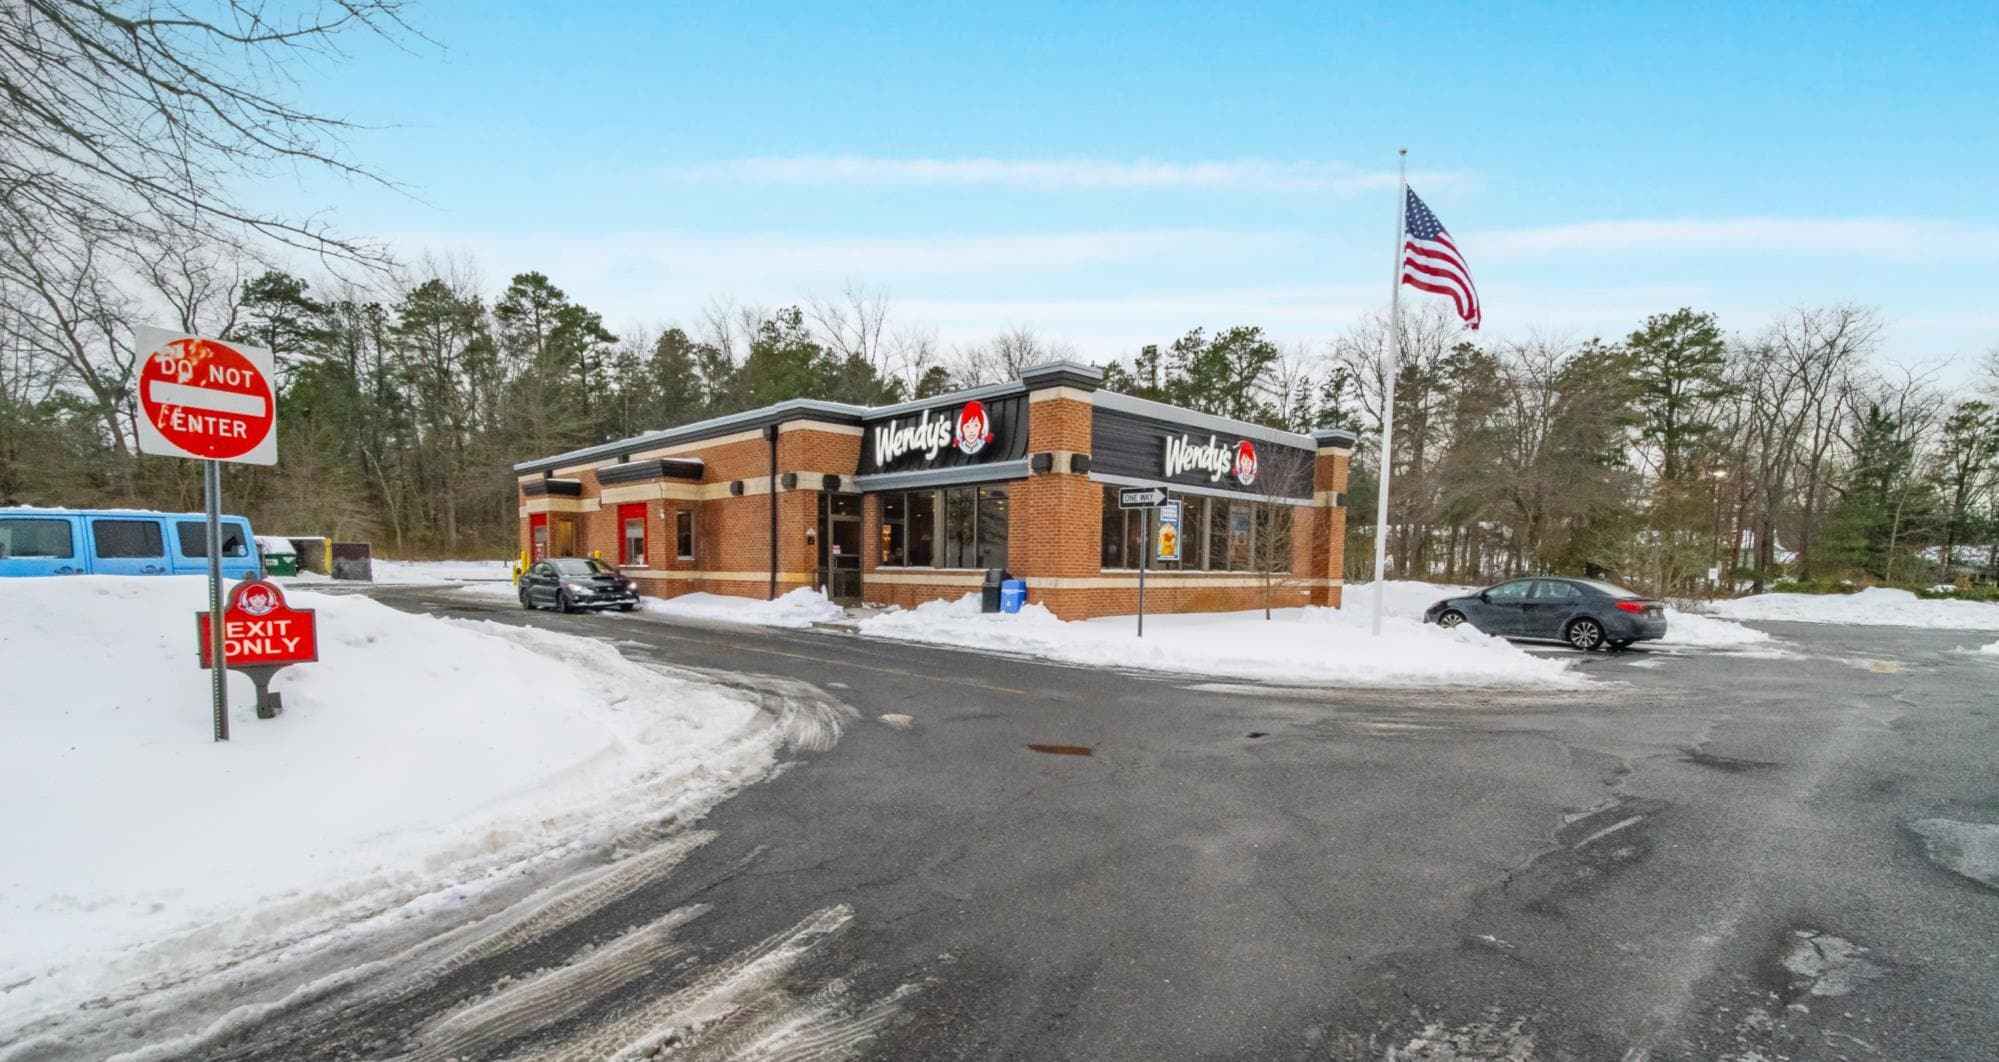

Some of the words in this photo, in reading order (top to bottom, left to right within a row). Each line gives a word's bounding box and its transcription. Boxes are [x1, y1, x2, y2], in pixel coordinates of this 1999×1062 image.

[160, 357, 194, 380] DO
[209, 364, 254, 388] NOT
[173, 413, 247, 439] ENTER
[875, 409, 952, 467] Wendy's
[1165, 434, 1232, 482] Wendy's
[1124, 494, 1138, 502] ONE
[1140, 493, 1154, 501] WAY
[226, 620, 292, 638] EXIT
[224, 637, 300, 656] ONLY
